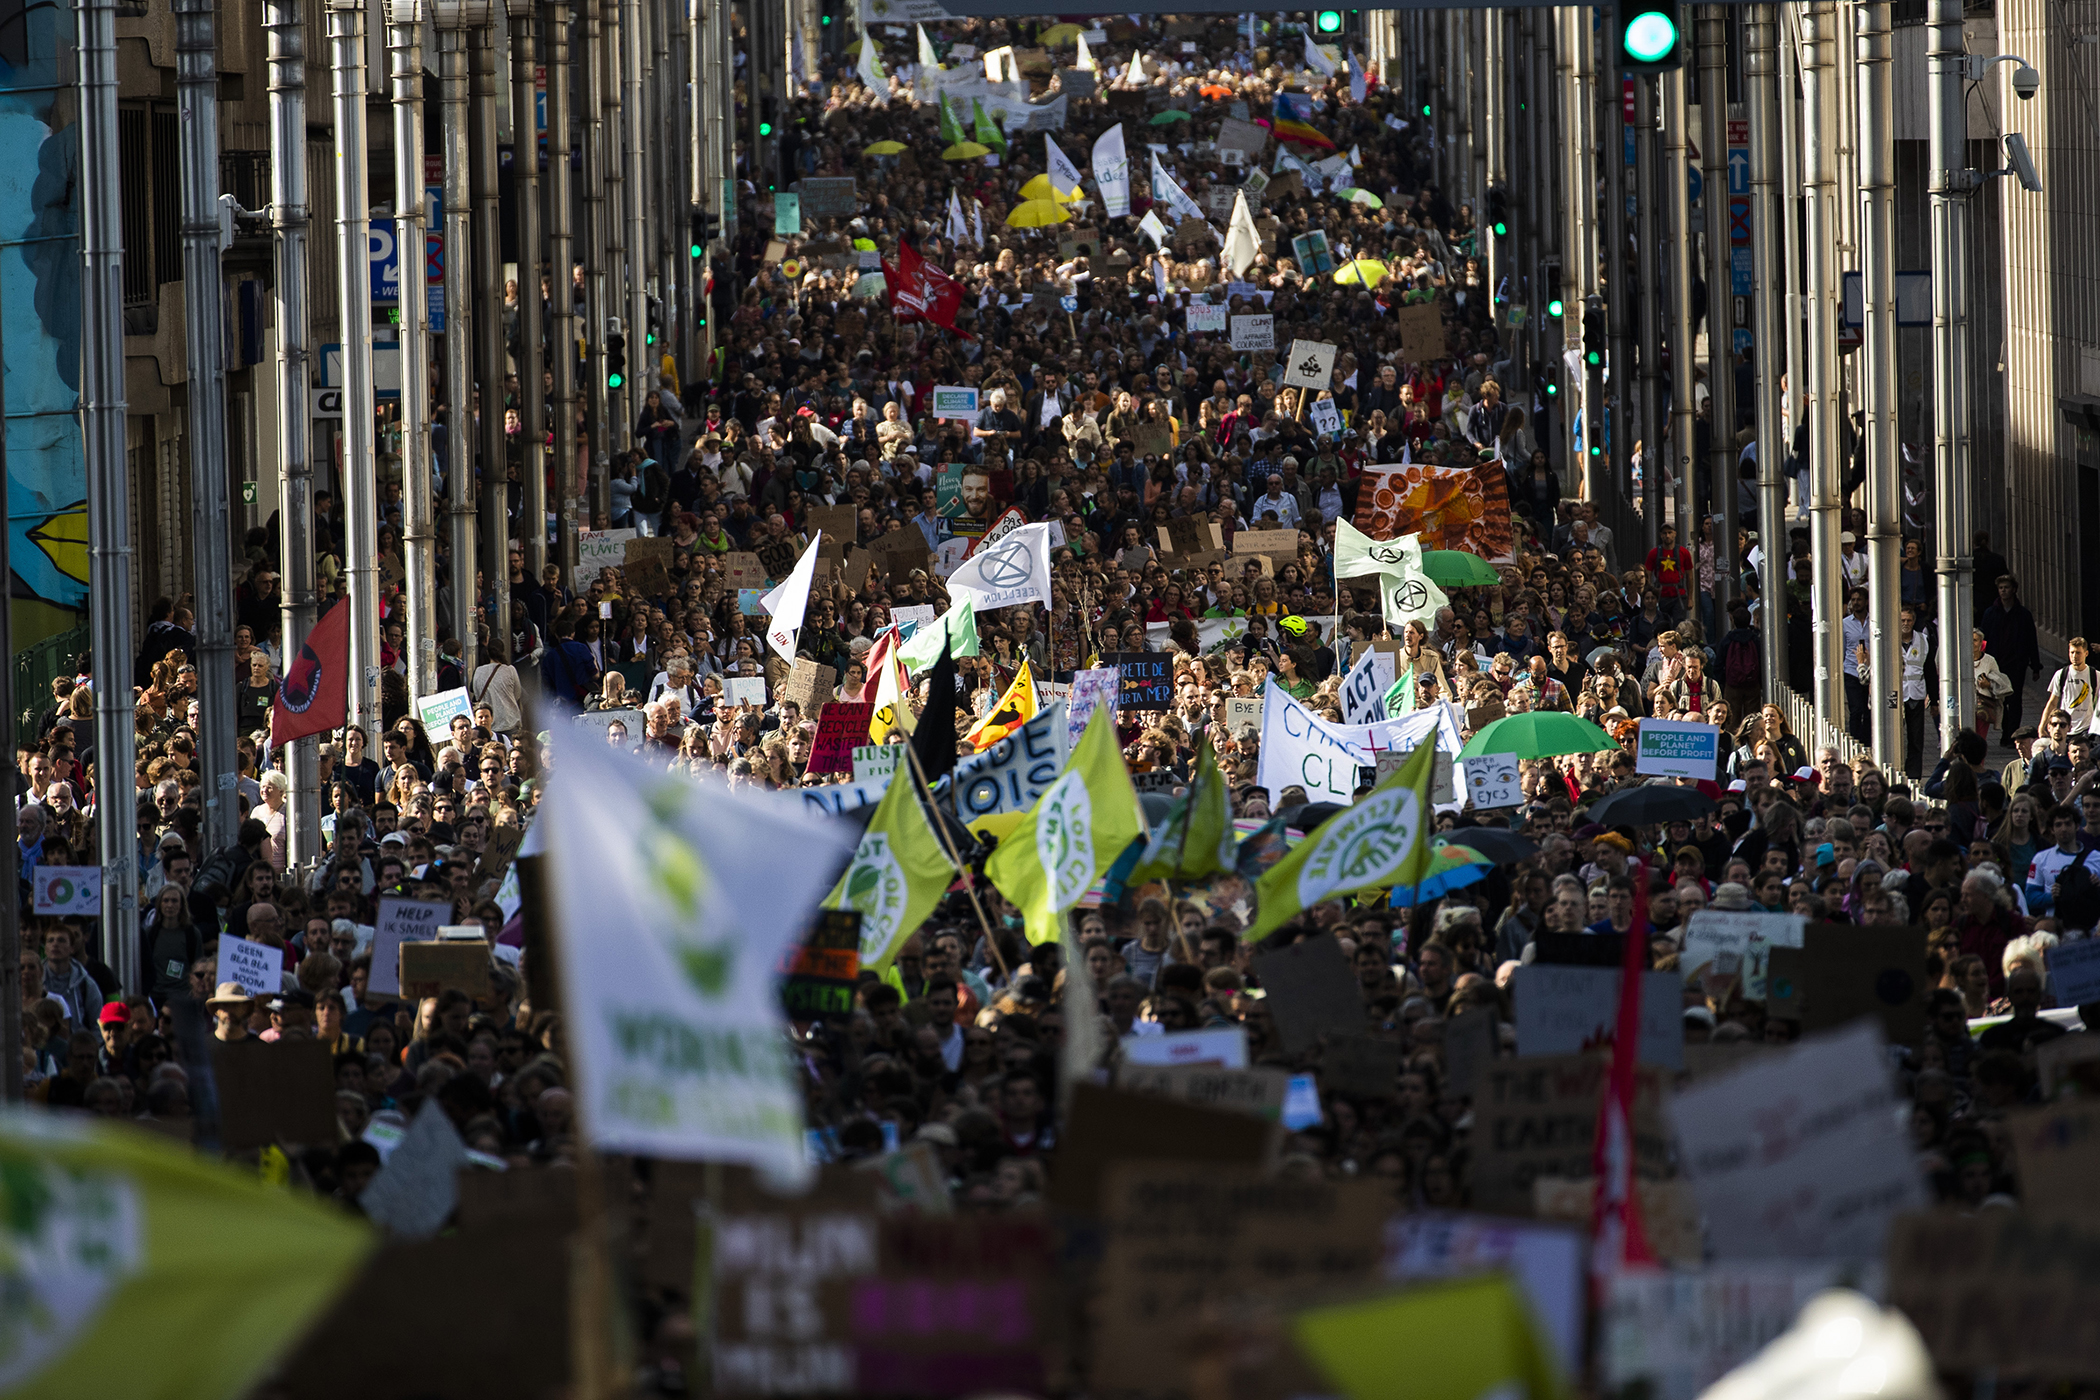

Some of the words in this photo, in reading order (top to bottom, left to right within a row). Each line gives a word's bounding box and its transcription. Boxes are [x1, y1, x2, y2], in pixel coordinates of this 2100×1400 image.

[1236, 341, 1272, 350] COURANTES
[1003, 516, 1022, 527] PAS
[580, 531, 604, 542] SAVE
[759, 542, 795, 566] GOOD
[766, 561, 795, 577] LUCK
[1152, 661, 1166, 677] DE
[1147, 685, 1170, 702] MER
[1346, 658, 1377, 718] ACT
[427, 702, 449, 716] PEOPLE
[449, 698, 463, 708] AND
[435, 707, 457, 719] PLANET
[1235, 702, 1254, 714] BYE
[819, 719, 869, 734] RECYCLE
[815, 736, 863, 752] WASTED
[1648, 733, 1687, 743] PEOPLE
[1687, 735, 1706, 744] AND
[1660, 741, 1696, 750] PLANET
[1642, 748, 1680, 758] BEFORE
[1680, 750, 1713, 759] PROFIT
[822, 755, 850, 770] TIME
[1477, 788, 1510, 805] EYES
[395, 906, 434, 920] HELP
[384, 922, 394, 933] IK
[237, 943, 263, 960] GEEN
[230, 952, 249, 967] BLA
[250, 957, 269, 972] BLA
[231, 971, 265, 990] BOOM
